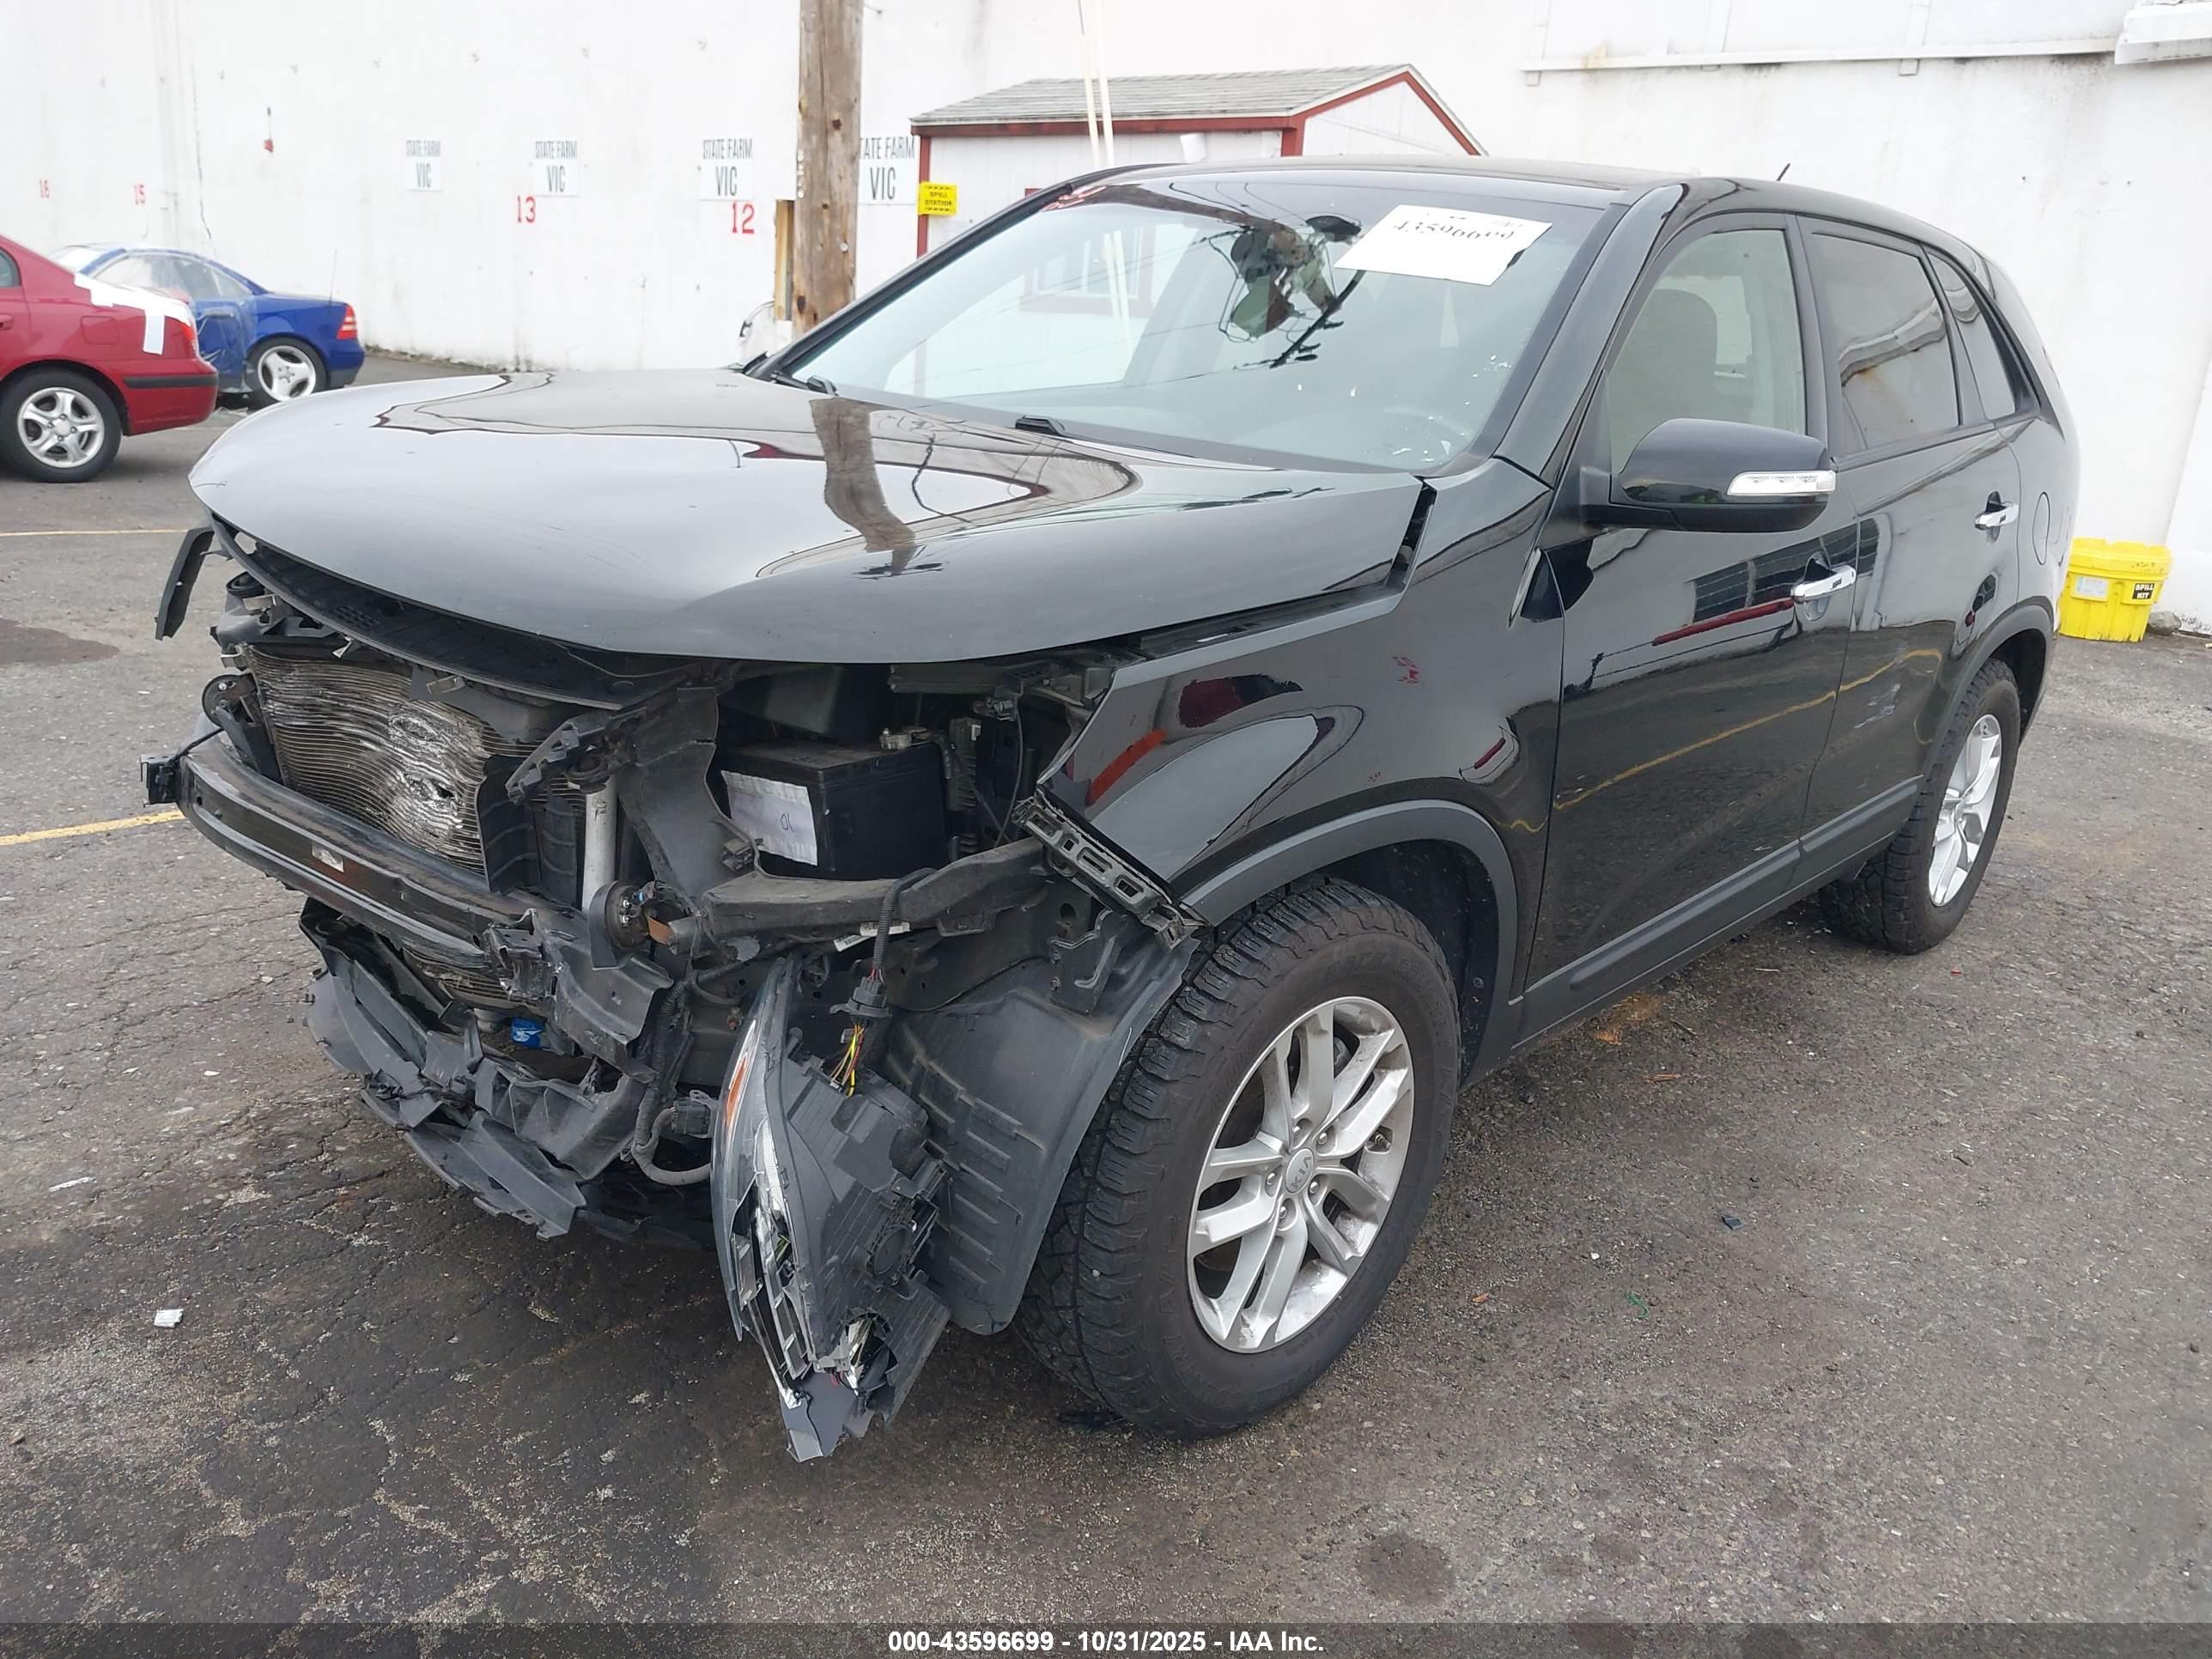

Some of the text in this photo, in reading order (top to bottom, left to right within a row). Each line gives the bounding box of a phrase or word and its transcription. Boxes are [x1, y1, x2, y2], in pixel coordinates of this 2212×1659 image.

[535, 140, 578, 159] STATE FARM
[702, 138, 753, 160] STATE FARM
[860, 137, 915, 160] ATE FARM
[416, 162, 432, 188] VIC
[546, 165, 566, 192] VIC
[715, 166, 738, 197] VIC
[870, 167, 896, 200] VIC
[517, 195, 537, 223] 13
[731, 201, 755, 234] 12
[2135, 583, 2154, 592] SPILL
[1291, 1156, 1313, 1190] KIA
